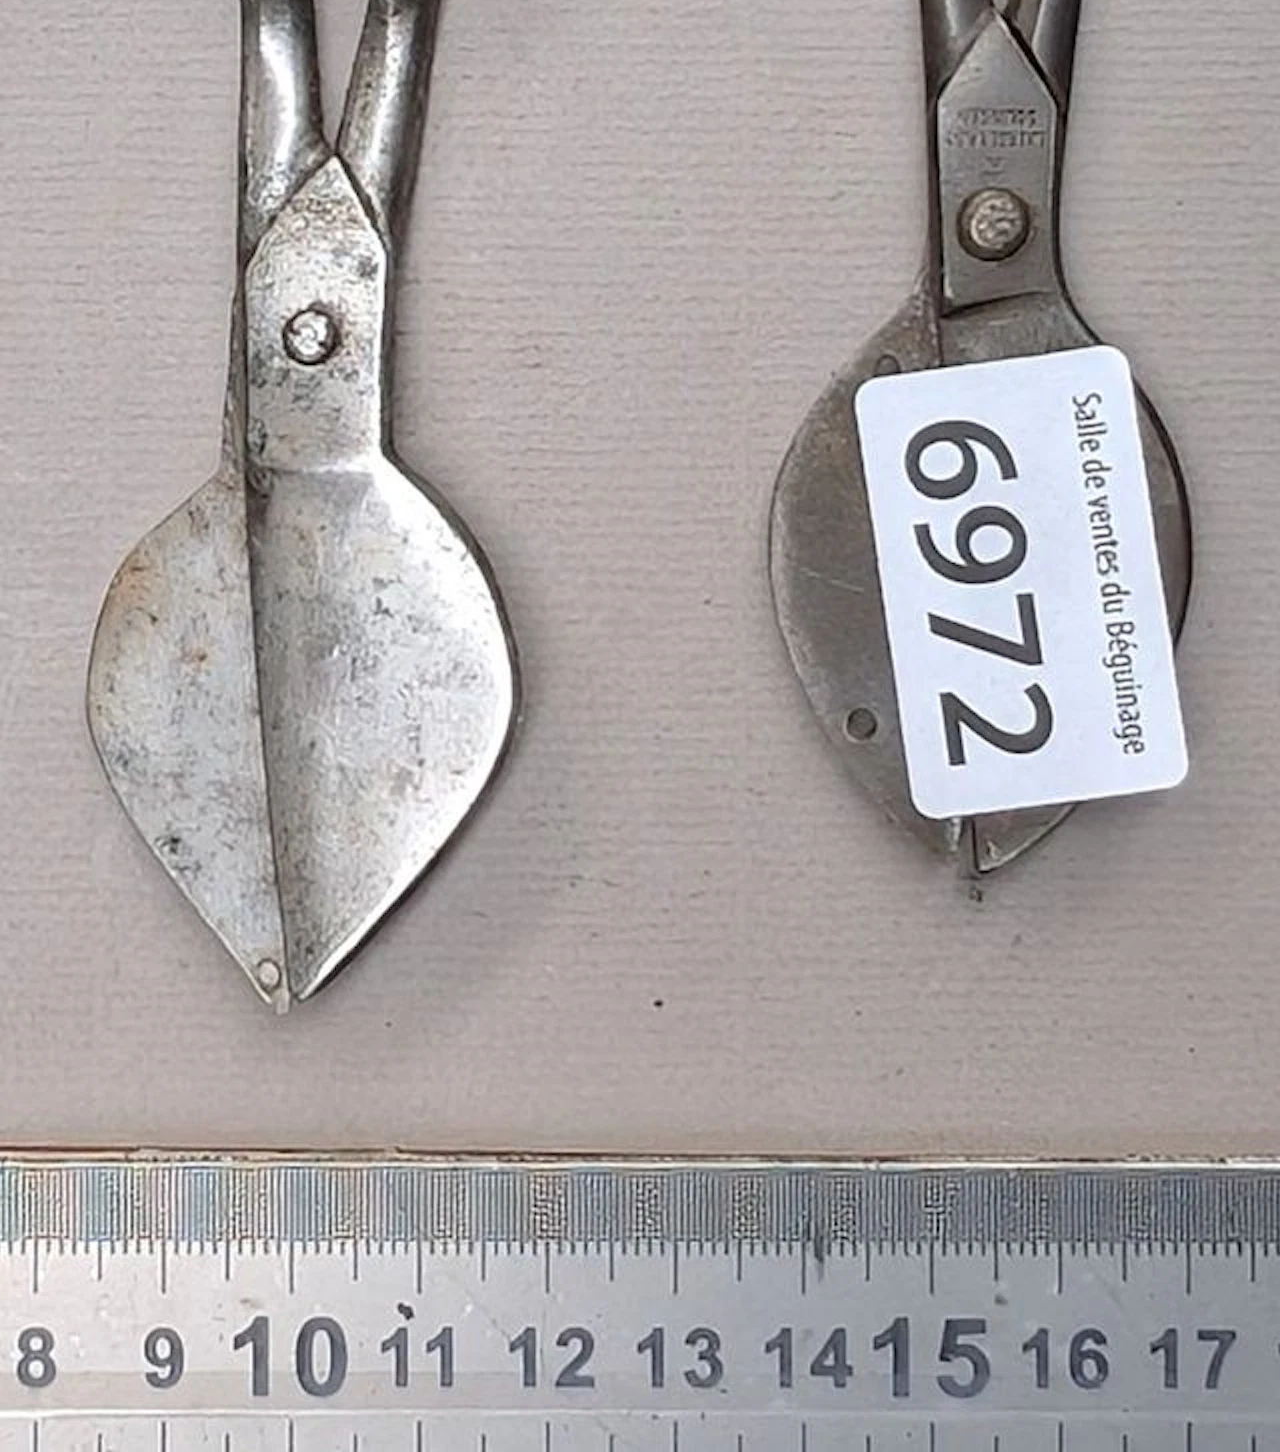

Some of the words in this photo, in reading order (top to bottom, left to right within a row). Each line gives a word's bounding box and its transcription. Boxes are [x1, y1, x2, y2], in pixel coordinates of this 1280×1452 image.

[1071, 392, 1107, 453] Salle
[1081, 459, 1113, 489] de
[1087, 494, 1120, 577] ventes
[903, 418, 1055, 768] 6972
[1099, 582, 1132, 615] du
[1101, 620, 1146, 755] Béguinage
[15, 1326, 57, 1390] 8
[143, 1326, 185, 1389] 9
[232, 1315, 349, 1399] 10
[380, 1326, 454, 1389] 11
[508, 1326, 596, 1389] 12
[636, 1327, 724, 1389] 13
[764, 1327, 854, 1389] 14
[872, 1316, 991, 1399] 15
[1021, 1327, 1110, 1390] 16
[1149, 1327, 1238, 1390] 17
